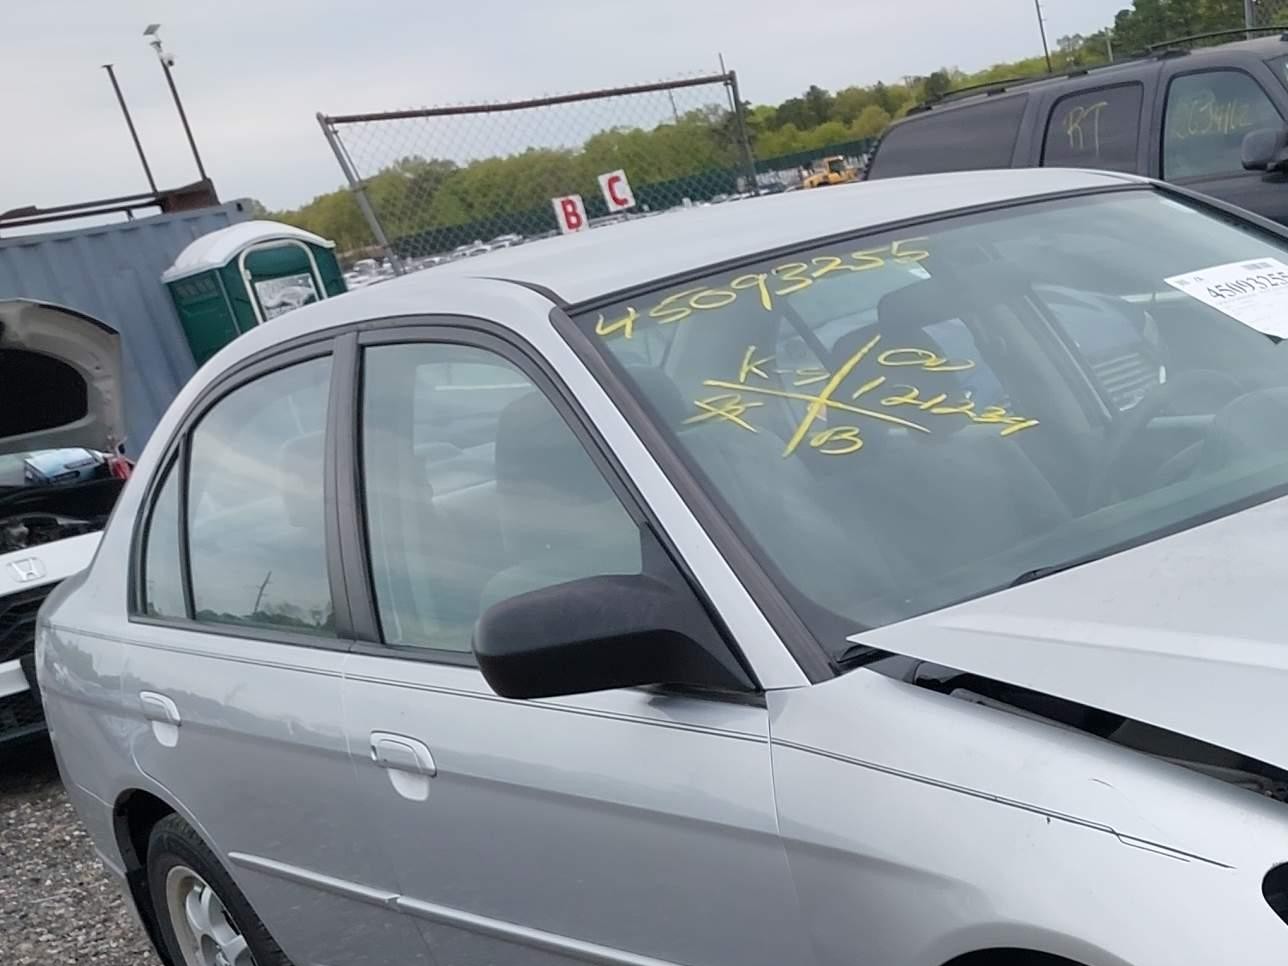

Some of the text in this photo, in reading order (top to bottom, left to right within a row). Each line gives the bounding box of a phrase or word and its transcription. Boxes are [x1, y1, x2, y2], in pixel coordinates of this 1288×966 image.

[607, 175, 629, 206] C
[561, 198, 583, 229] B
[595, 236, 930, 339] 45093255
